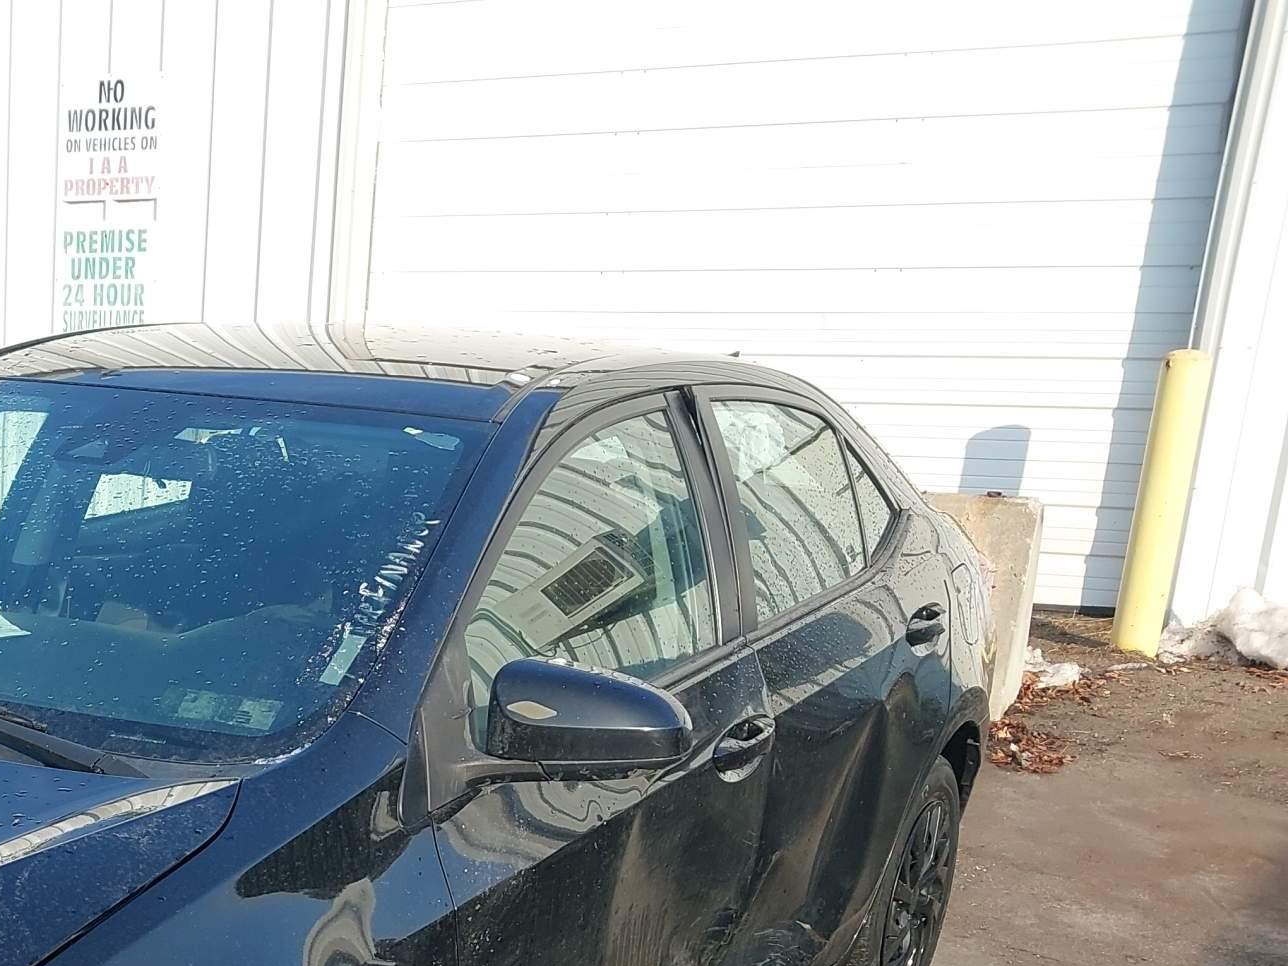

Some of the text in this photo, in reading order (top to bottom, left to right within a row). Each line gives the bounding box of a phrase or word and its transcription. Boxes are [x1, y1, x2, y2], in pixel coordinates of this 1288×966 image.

[98, 79, 124, 103] NO
[68, 106, 156, 132] WORKING
[66, 136, 157, 152] ON VEHICLES ON
[64, 176, 155, 196] PROPERTY
[64, 229, 147, 254] PREMISE
[71, 256, 136, 280] UNDER
[63, 283, 145, 307] 24 HOUR
